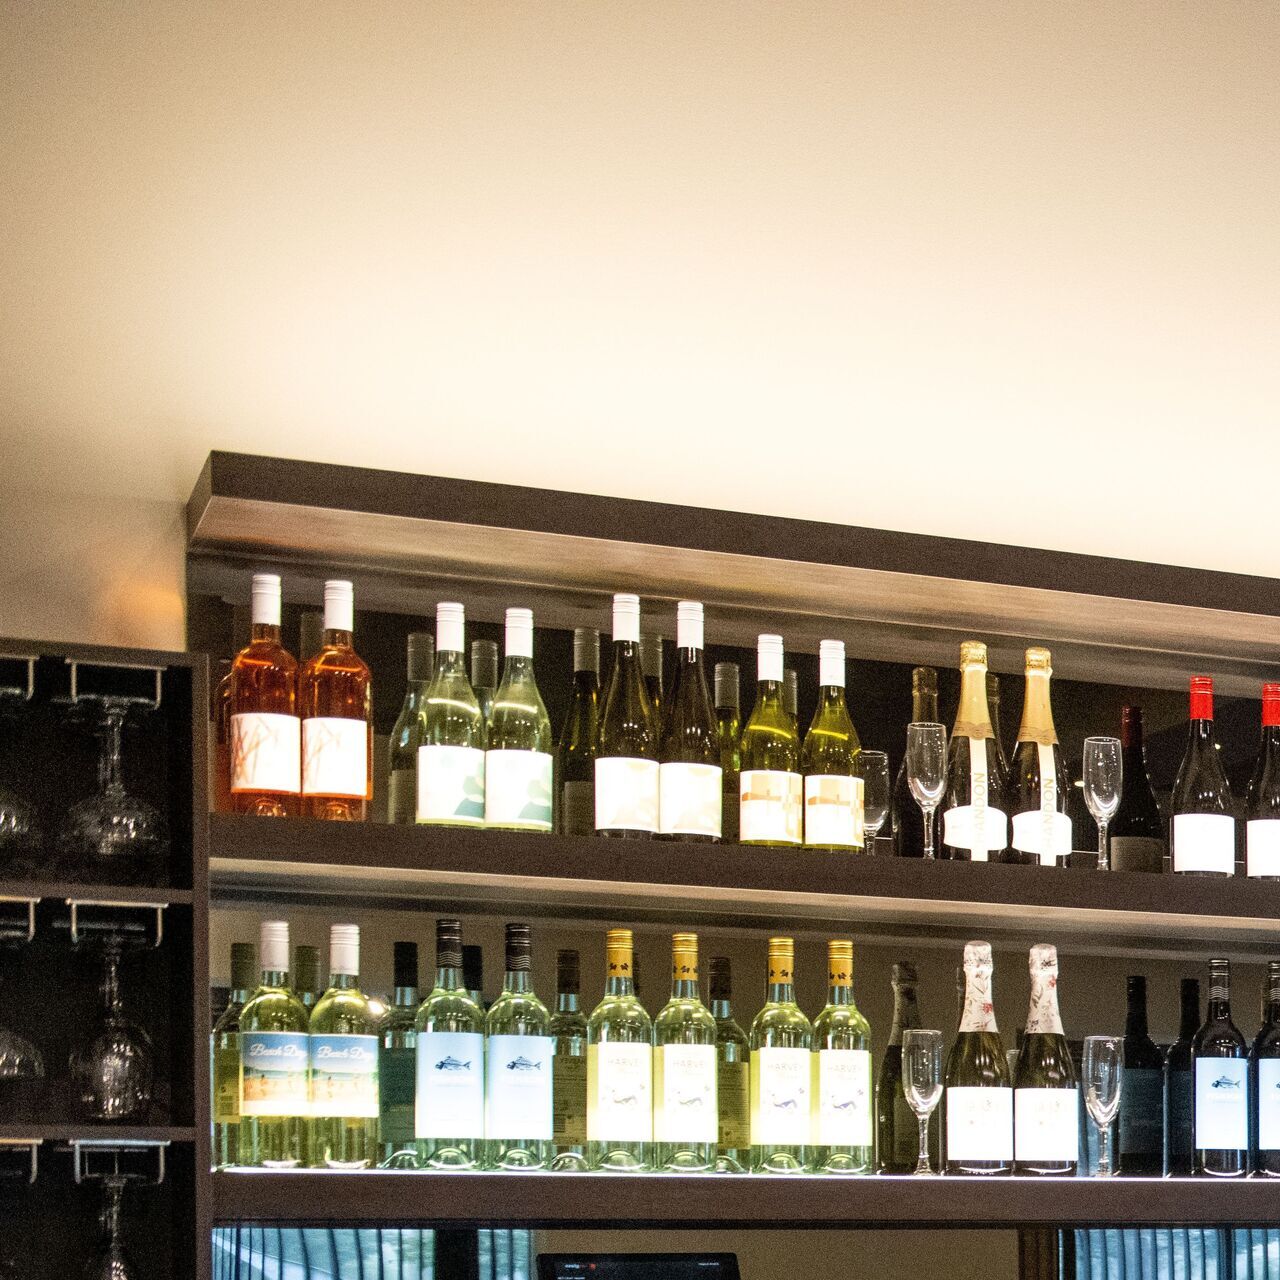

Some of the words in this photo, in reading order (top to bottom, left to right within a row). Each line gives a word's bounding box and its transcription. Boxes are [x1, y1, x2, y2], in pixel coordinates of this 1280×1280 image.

[973, 772, 986, 844] HANDON
[1042, 778, 1054, 849] HANDON
[249, 1043, 283, 1057] Beach
[317, 1046, 350, 1059] Beach
[607, 1057, 641, 1066] HARVE
[672, 1059, 708, 1069] HARVE
